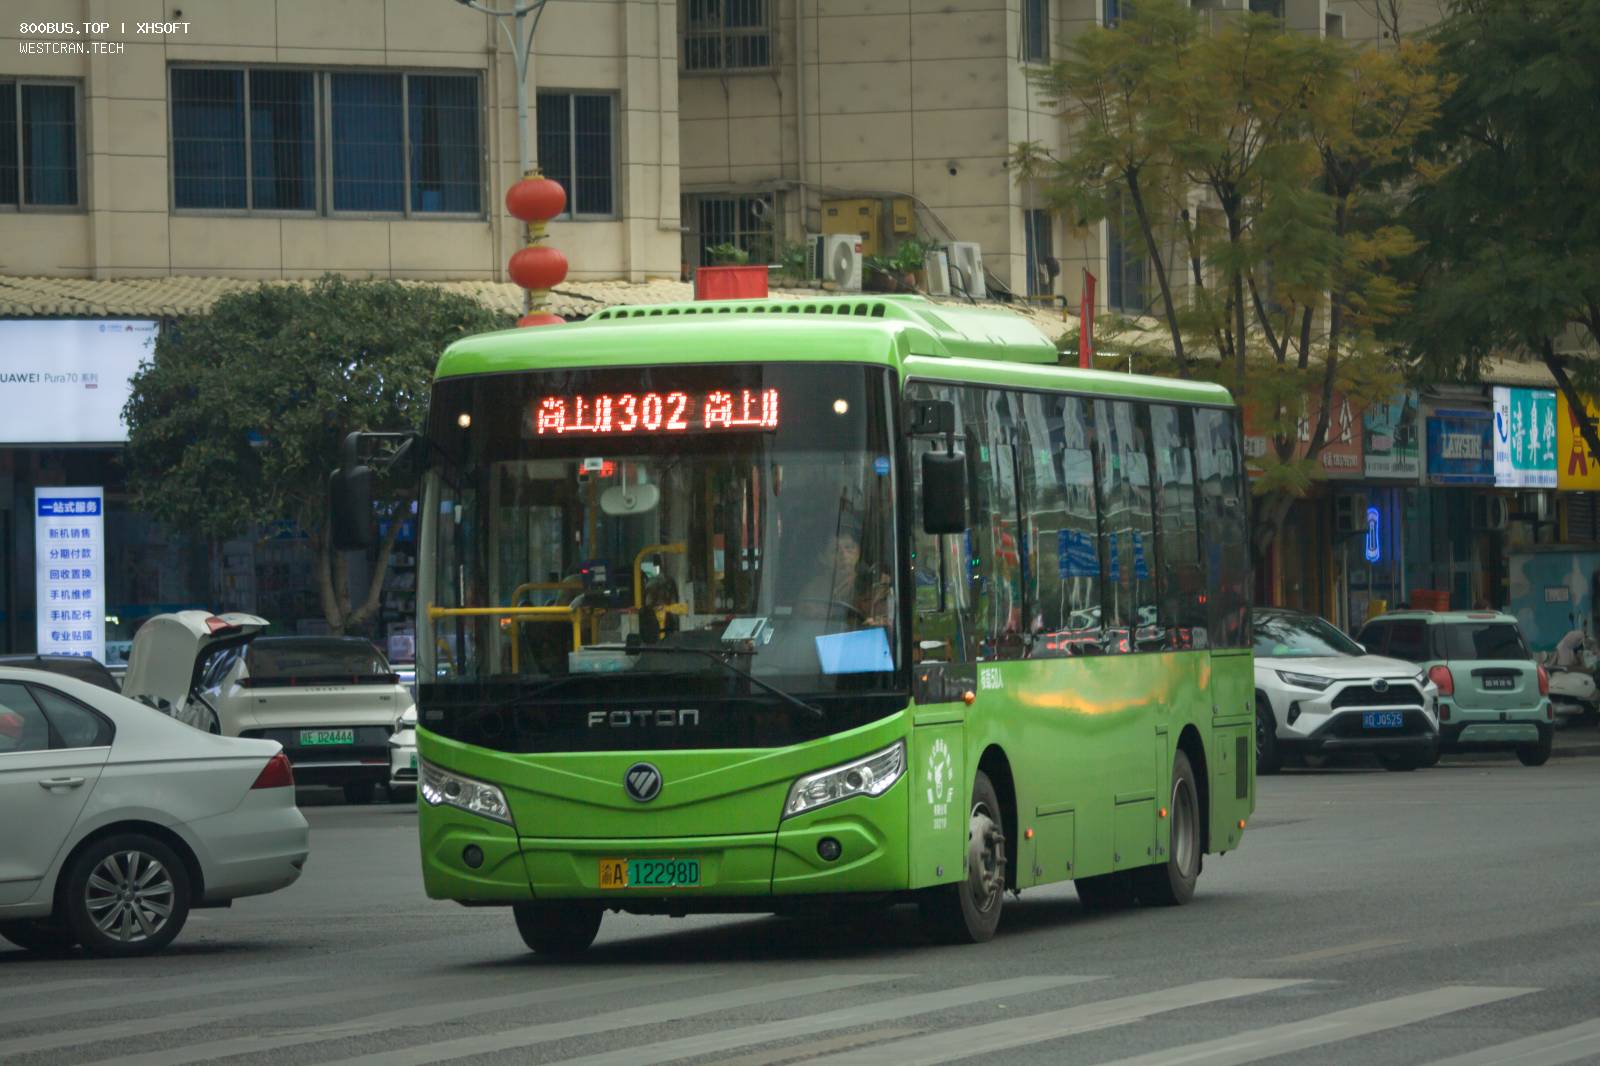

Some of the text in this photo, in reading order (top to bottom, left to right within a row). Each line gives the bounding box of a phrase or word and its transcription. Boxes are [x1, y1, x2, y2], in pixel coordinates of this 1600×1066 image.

[41, 501, 97, 513] 一站式服务
[49, 528, 90, 539] 新机销售
[50, 548, 91, 559] 分期付款
[49, 569, 91, 580] 回收置换
[50, 589, 92, 600] 手机维修
[51, 610, 92, 621] 手机配件
[51, 630, 93, 641] 专业贴膜
[587, 709, 699, 728] FOTON
